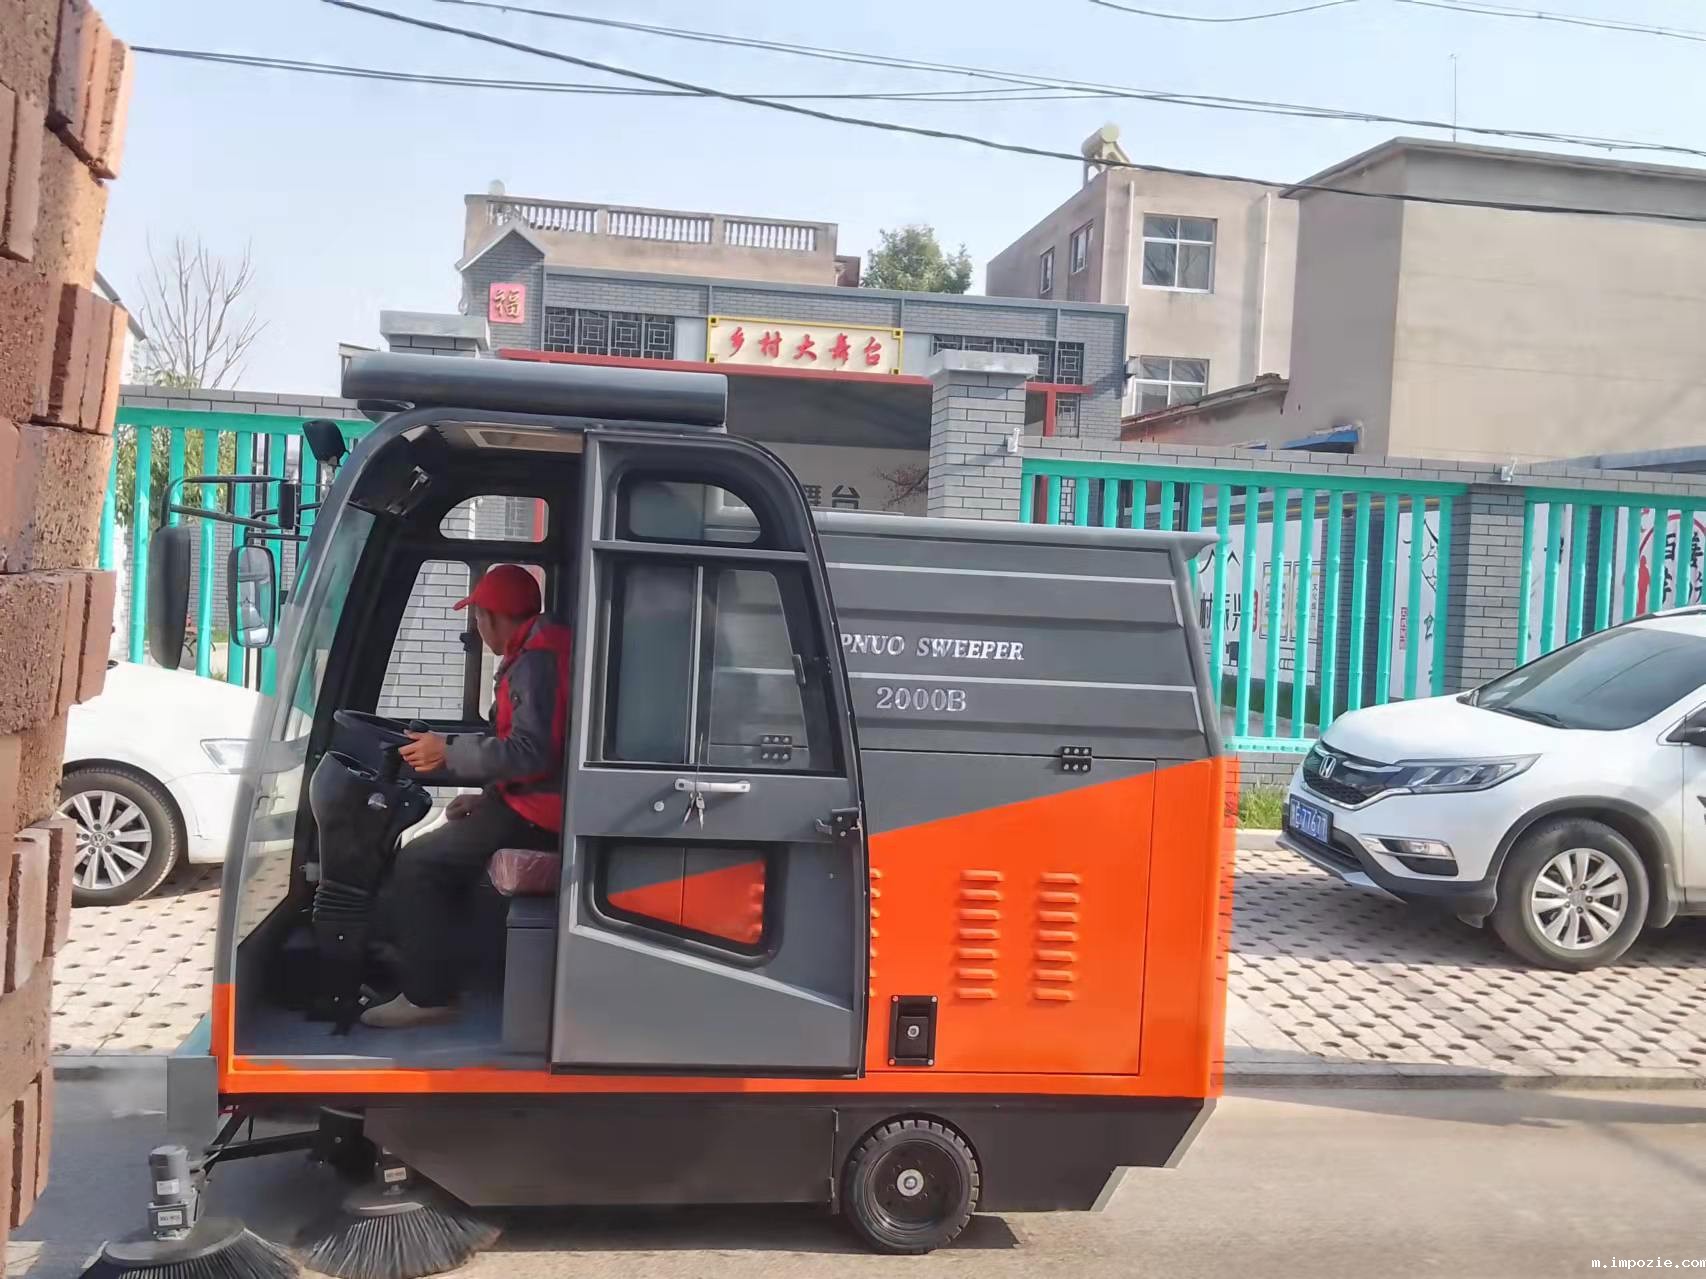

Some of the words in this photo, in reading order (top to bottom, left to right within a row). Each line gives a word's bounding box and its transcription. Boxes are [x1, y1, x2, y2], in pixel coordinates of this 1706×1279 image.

[494, 288, 521, 318] 福
[728, 326, 883, 366] 乡村大舞台
[916, 637, 1025, 661] SWEEPER
[876, 686, 968, 712] 2000B
